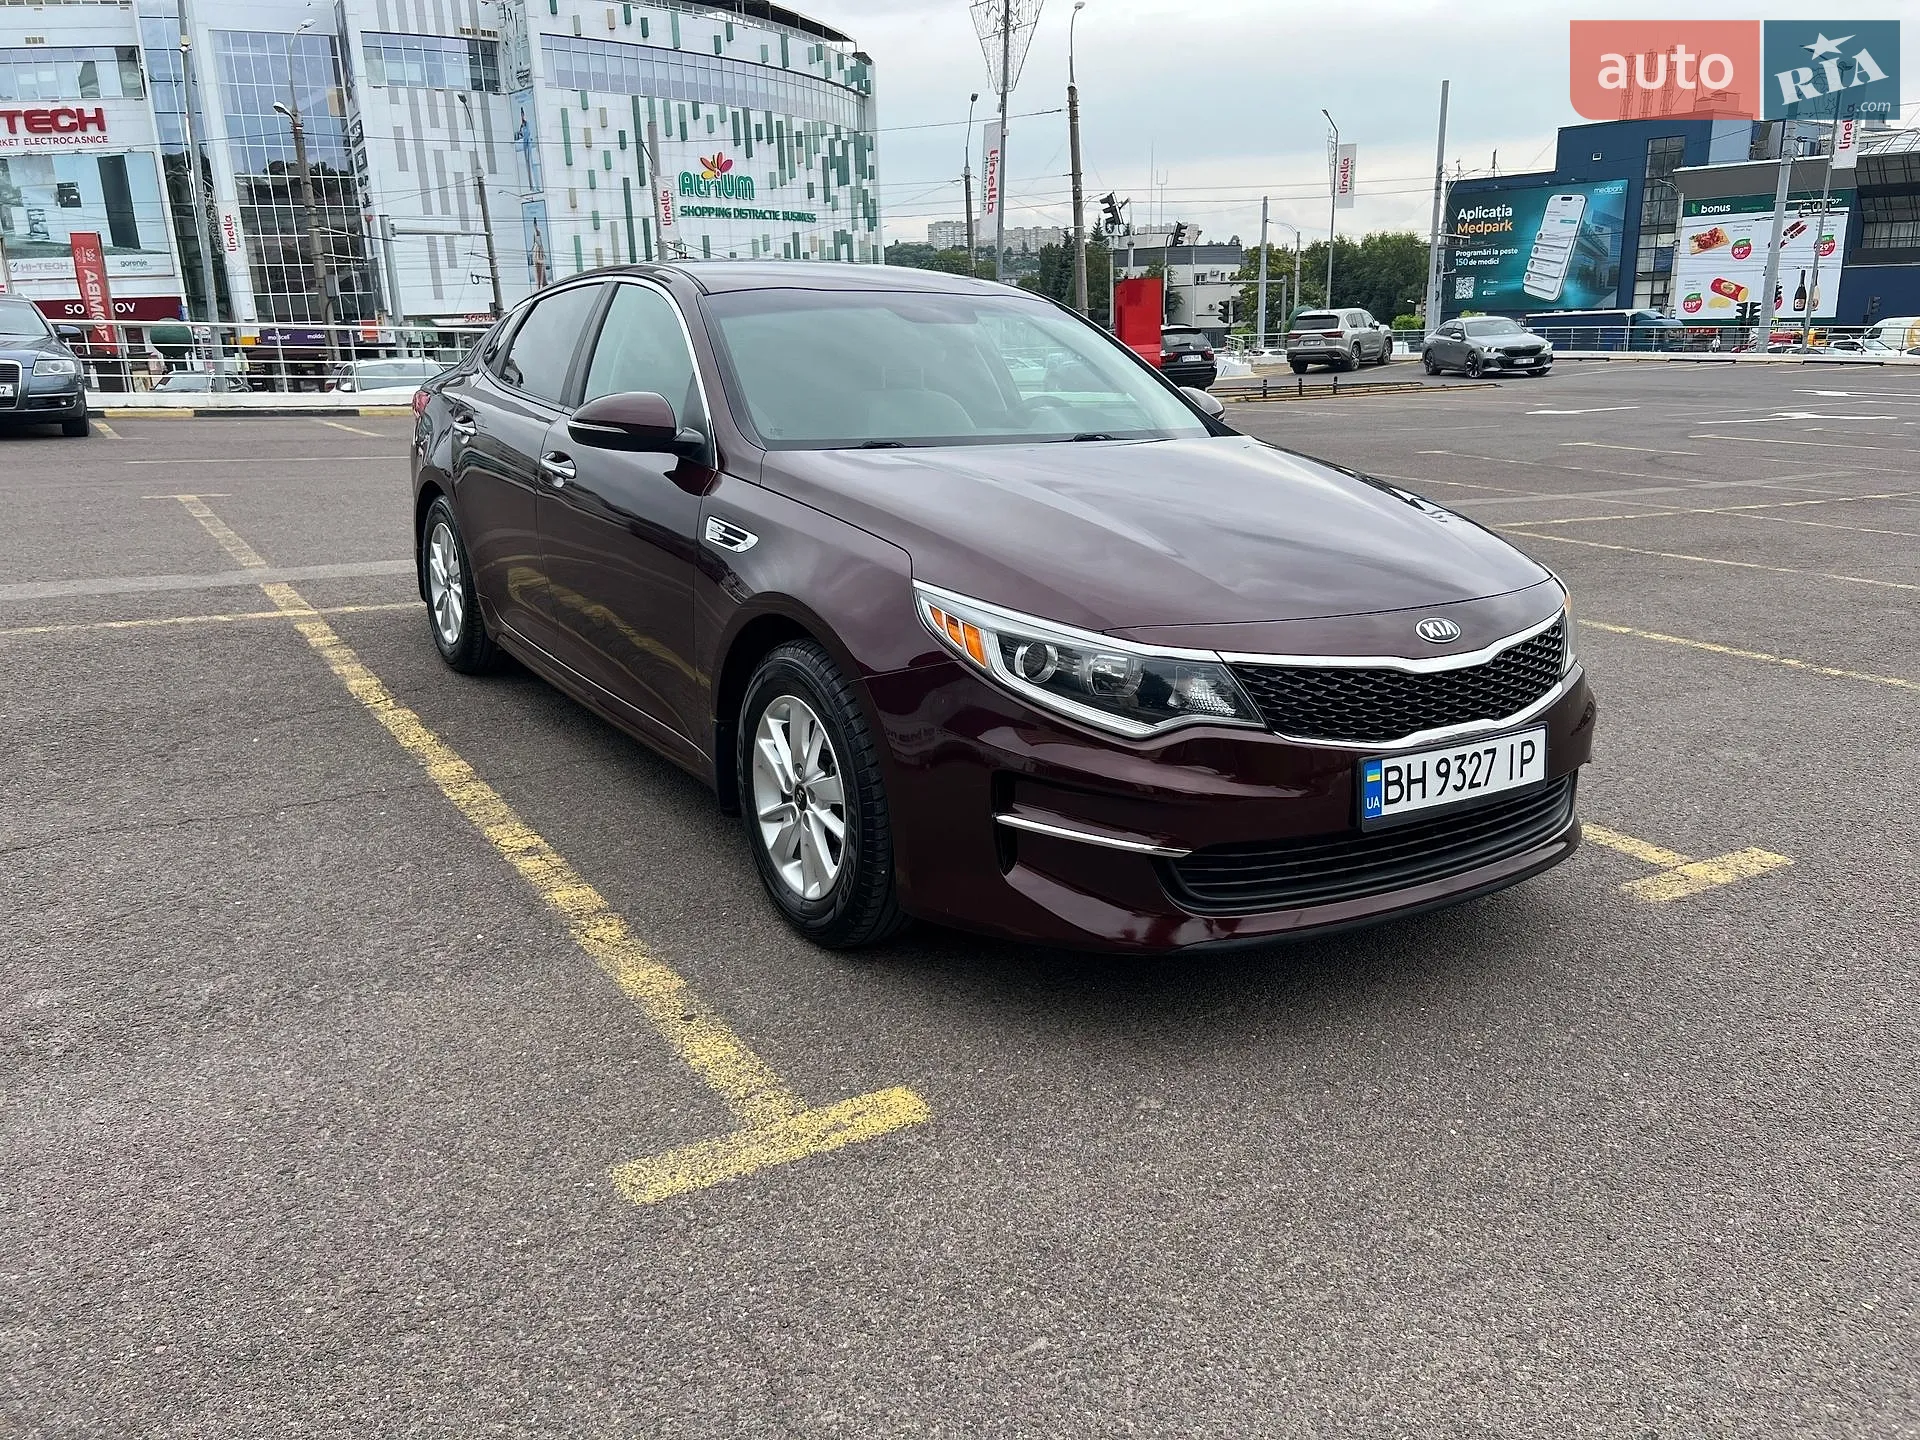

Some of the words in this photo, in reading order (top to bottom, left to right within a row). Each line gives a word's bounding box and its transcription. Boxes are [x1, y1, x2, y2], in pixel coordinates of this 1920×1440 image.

[24, 135, 108, 146] ELECTROCASNICE
[987, 149, 999, 216] linella
[1339, 157, 1350, 194] linella
[1593, 185, 1624, 194] medpark
[661, 190, 672, 226] linella
[679, 205, 733, 217] SHOPPING
[733, 207, 781, 220] DISTRACTIE
[782, 210, 817, 223] BUSINESS
[1701, 204, 1731, 214] bonus
[223, 214, 237, 252] linella
[1457, 220, 1513, 235] Medpark
[1455, 248, 1492, 258] Programări
[1499, 247, 1519, 256] peste
[120, 259, 148, 268] gorenje
[1455, 258, 1469, 266] 150
[1468, 258, 1477, 266] de
[1477, 257, 1500, 265] medici
[1421, 620, 1459, 638] KIA
[1384, 760, 1427, 806] BH
[1435, 747, 1497, 796] 9327
[1508, 739, 1536, 780] IP
[1366, 796, 1381, 810] UA
